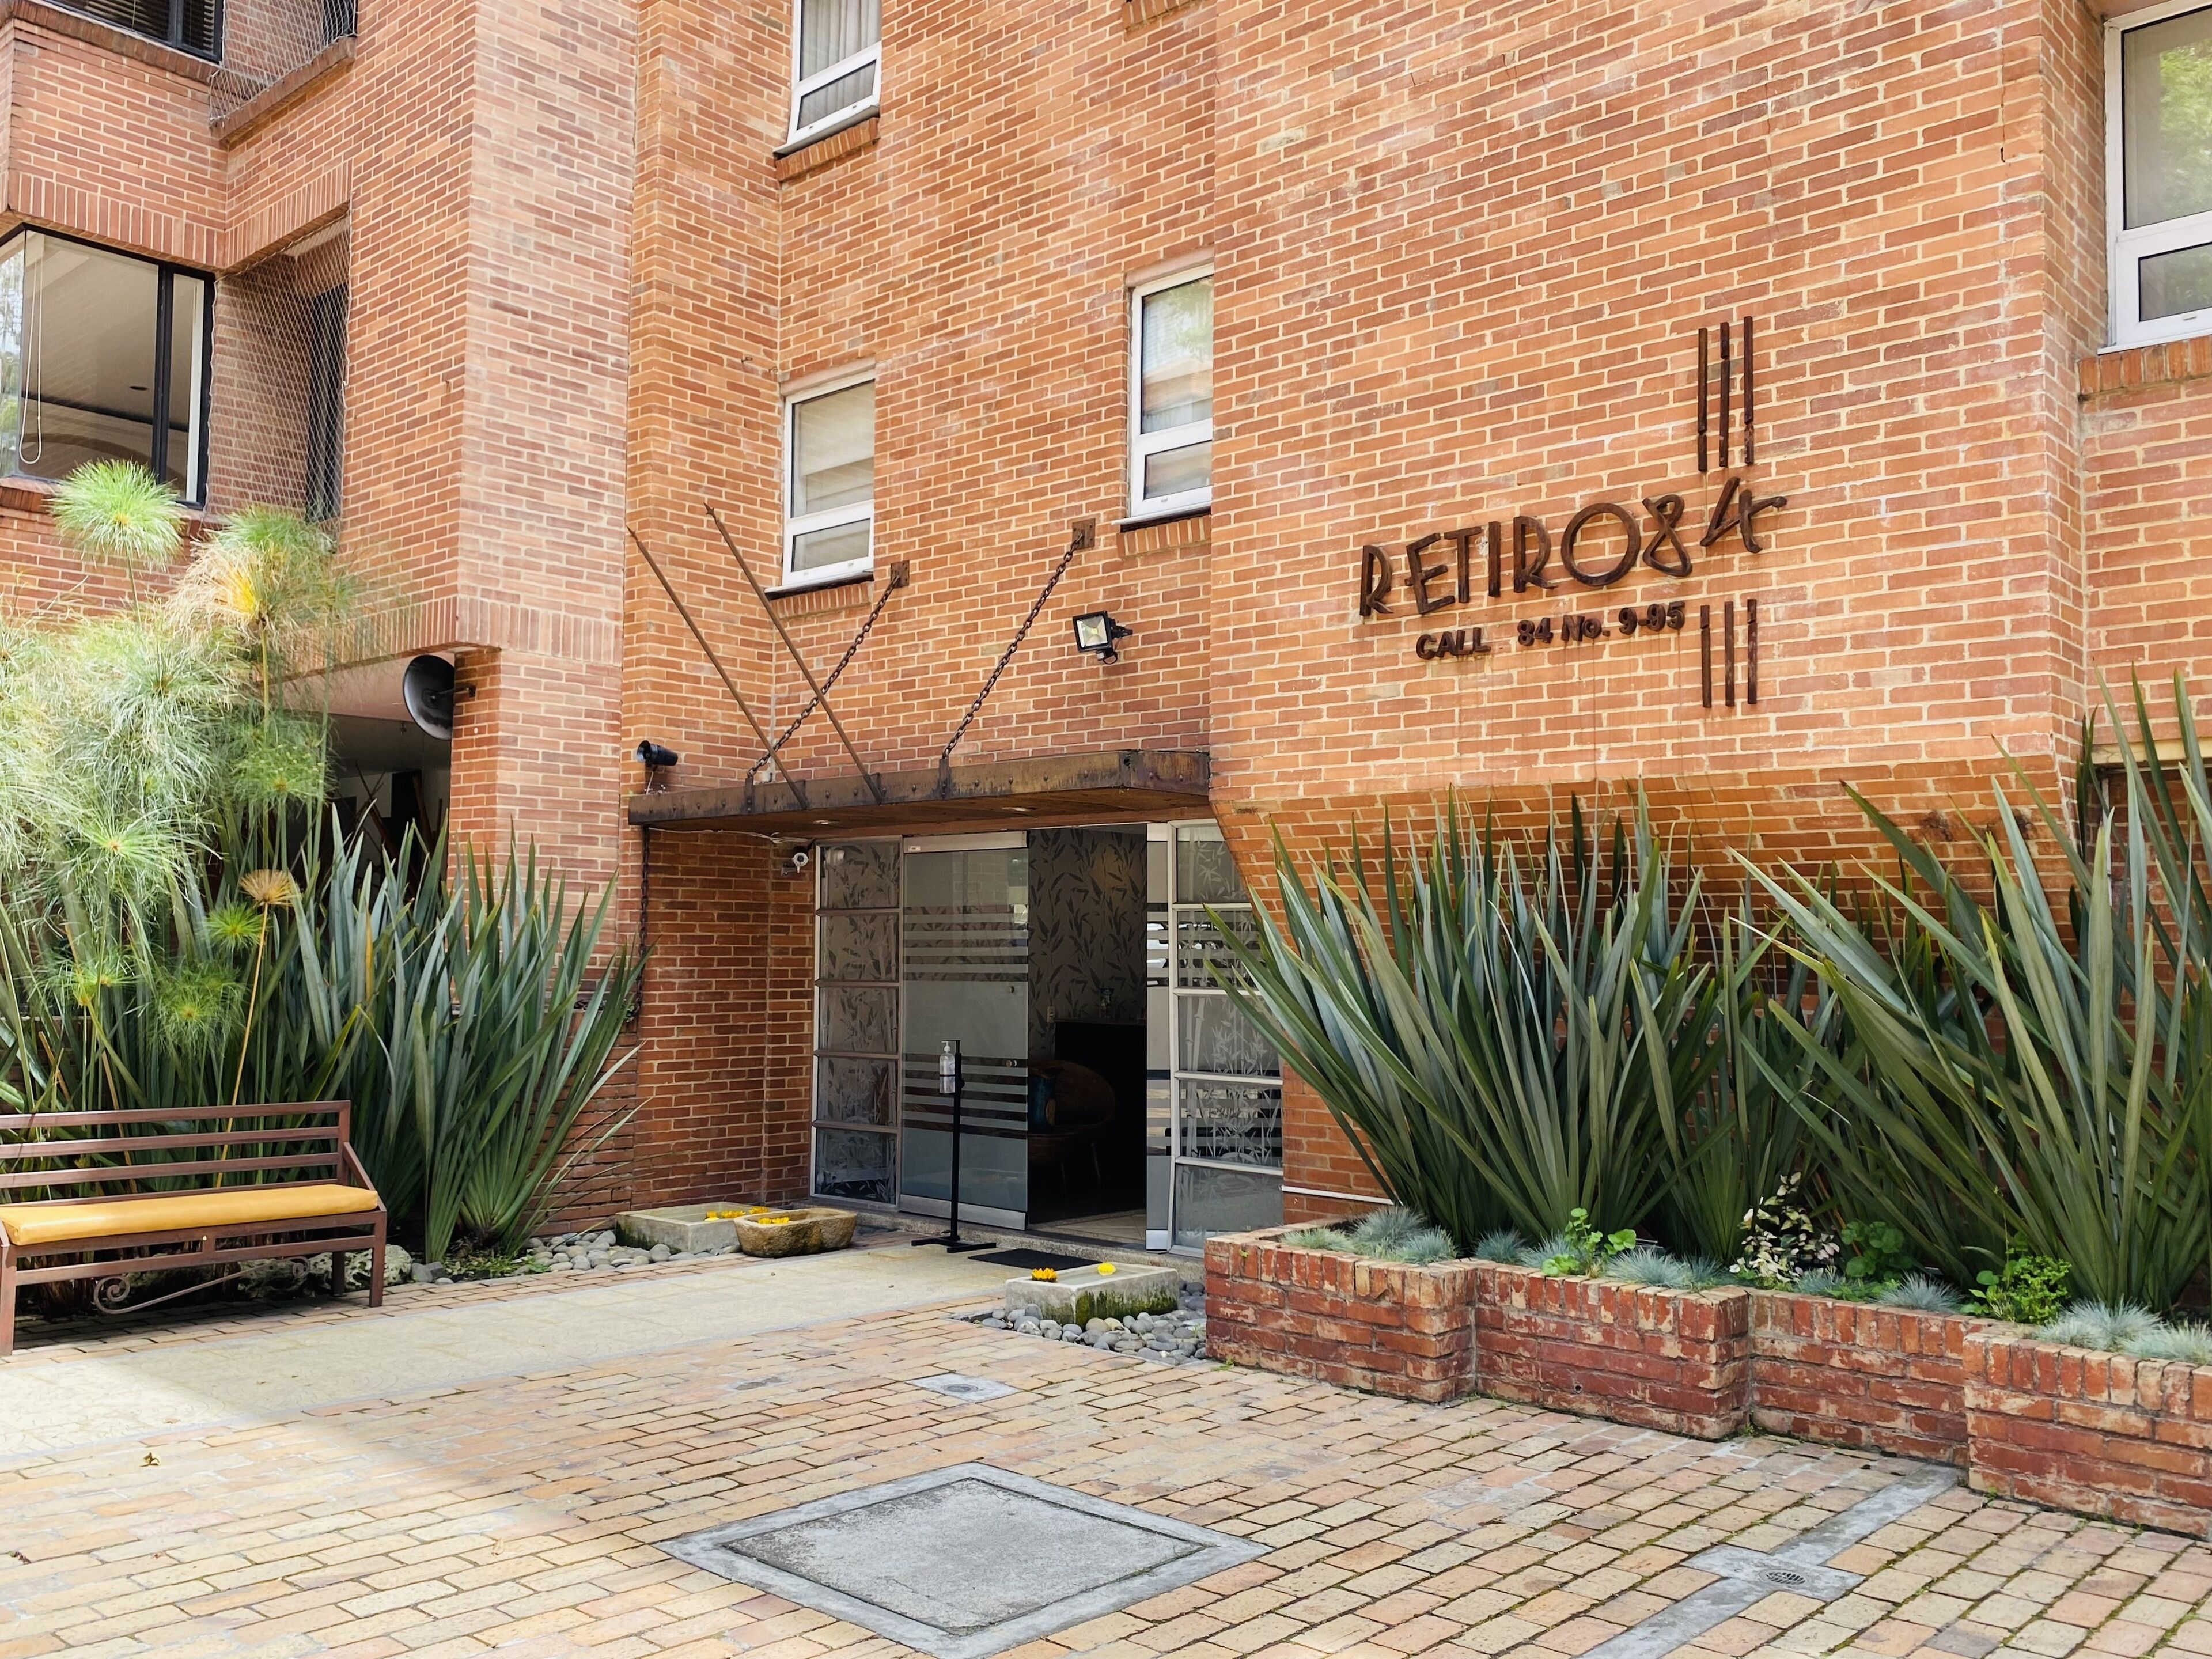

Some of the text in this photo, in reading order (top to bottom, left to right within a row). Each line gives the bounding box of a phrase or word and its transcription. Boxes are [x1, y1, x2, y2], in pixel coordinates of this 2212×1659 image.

[1415, 627, 1491, 660] CALL
[1517, 617, 1554, 646] 84
[1618, 601, 1686, 635] 9-95
